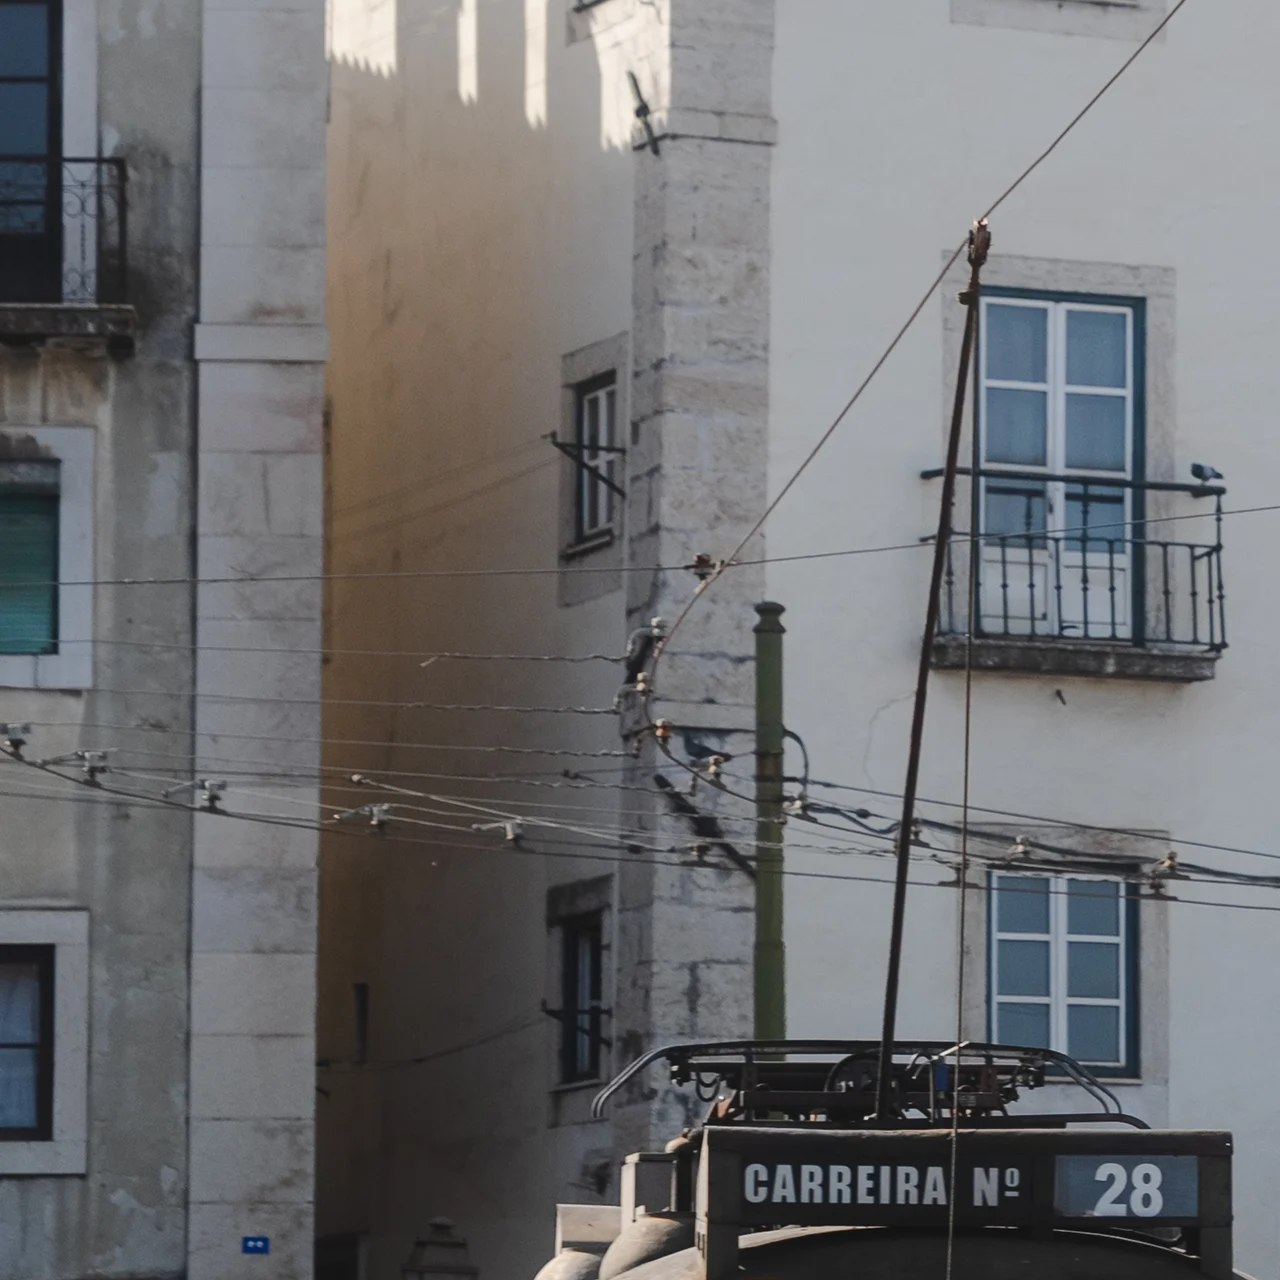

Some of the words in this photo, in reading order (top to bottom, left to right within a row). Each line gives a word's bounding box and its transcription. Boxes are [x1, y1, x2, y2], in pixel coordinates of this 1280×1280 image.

[744, 1163, 948, 1206] CARREIRA
[973, 1166, 1021, 1207] Nº
[1093, 1162, 1164, 1217] 28
